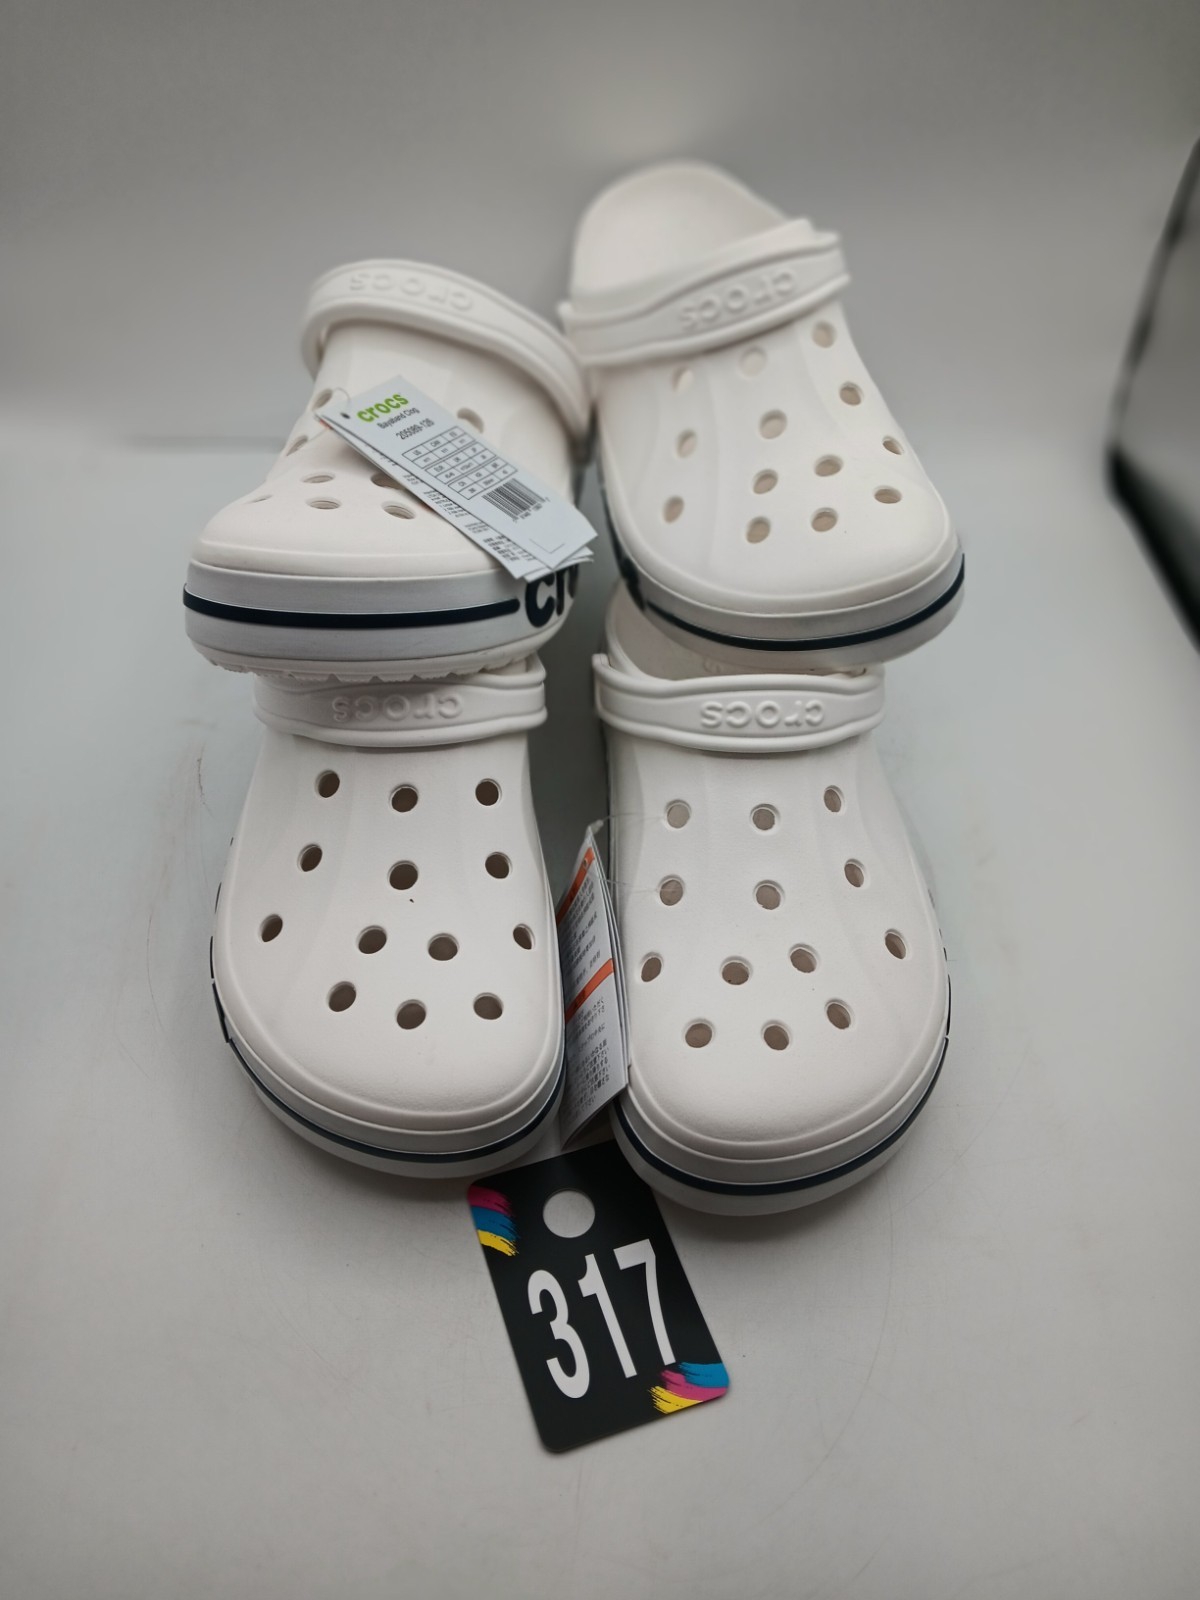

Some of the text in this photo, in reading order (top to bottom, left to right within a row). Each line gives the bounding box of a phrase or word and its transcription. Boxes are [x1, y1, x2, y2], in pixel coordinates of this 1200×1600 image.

[349, 272, 473, 311] crocs
[681, 270, 799, 330] crocs
[357, 394, 409, 422] crocs
[330, 695, 463, 721] crocs
[699, 698, 826, 728] crocs
[527, 1238, 676, 1399] 317
